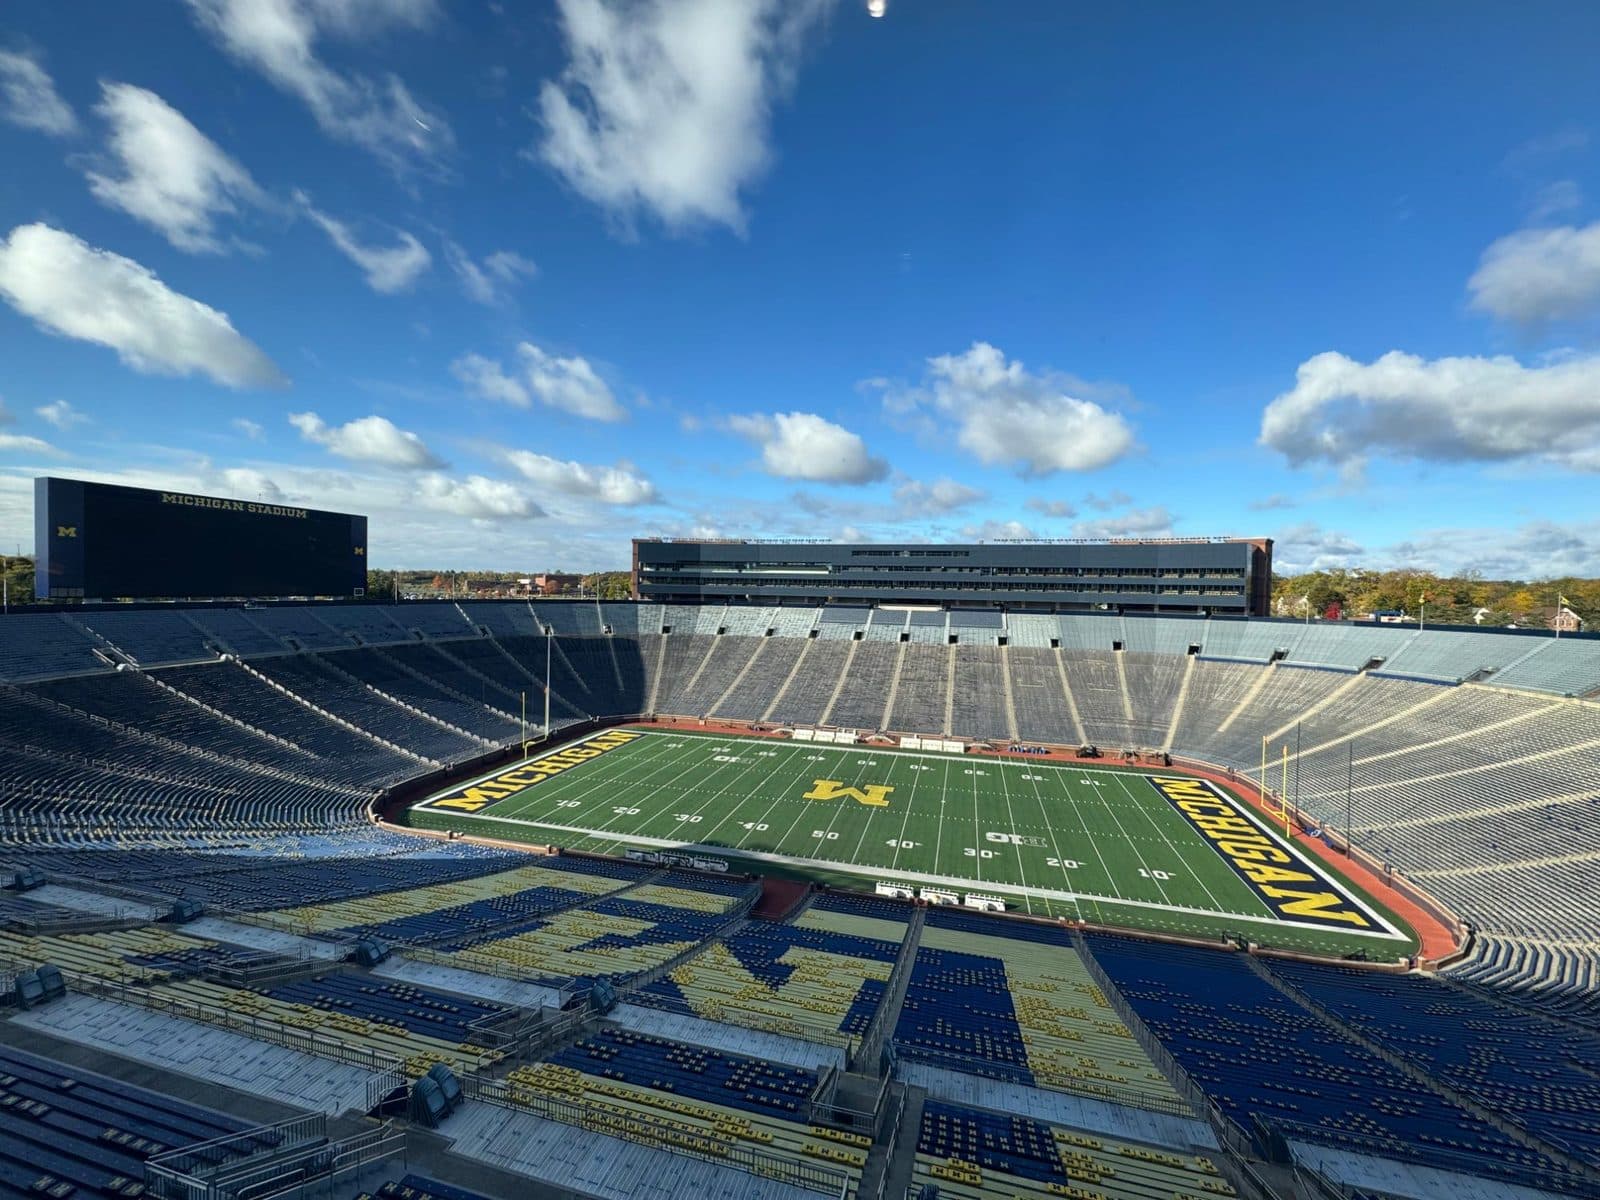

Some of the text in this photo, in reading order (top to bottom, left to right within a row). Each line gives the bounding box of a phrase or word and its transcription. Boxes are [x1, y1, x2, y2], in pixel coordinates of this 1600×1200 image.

[161, 493, 307, 518] MICHIGAN STADIUM
[58, 526, 77, 537] M
[434, 731, 641, 812] MICHIGAN
[802, 779, 895, 807] M
[558, 800, 582, 808] 10
[615, 806, 641, 815] 20
[675, 813, 703, 824] 30
[741, 821, 770, 832] 40
[811, 830, 840, 841] 50
[885, 839, 914, 849] 40
[963, 847, 994, 859] 30
[1151, 777, 1371, 928] MICHIGAN
[1046, 857, 1080, 869] 20
[1137, 868, 1170, 880] 10
